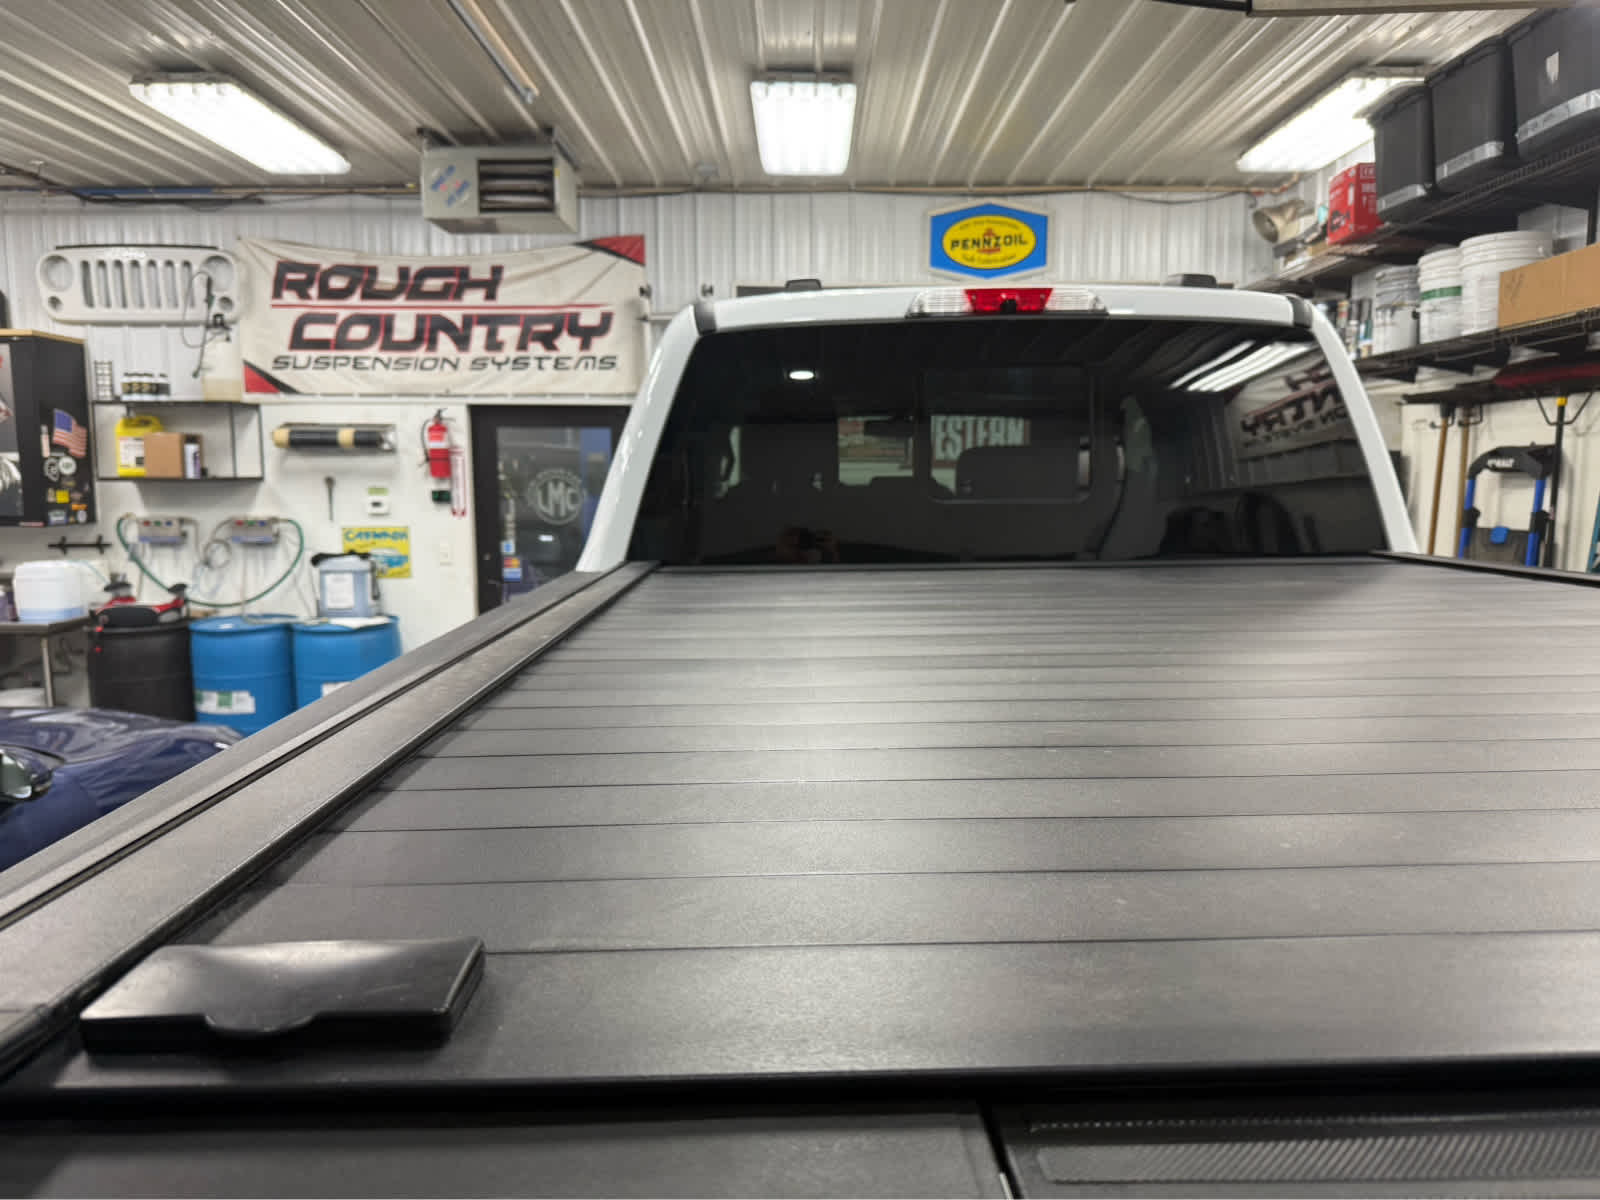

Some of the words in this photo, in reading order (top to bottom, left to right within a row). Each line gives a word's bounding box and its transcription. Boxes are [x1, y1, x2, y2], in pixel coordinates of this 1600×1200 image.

[950, 233, 1028, 251] PENNZOIL
[272, 261, 504, 301] ROUGH
[288, 312, 614, 352] COUNTRY
[272, 355, 460, 371] SUSPENSION
[471, 355, 617, 371] SYSTEMS
[931, 415, 1025, 460] ESTERN
